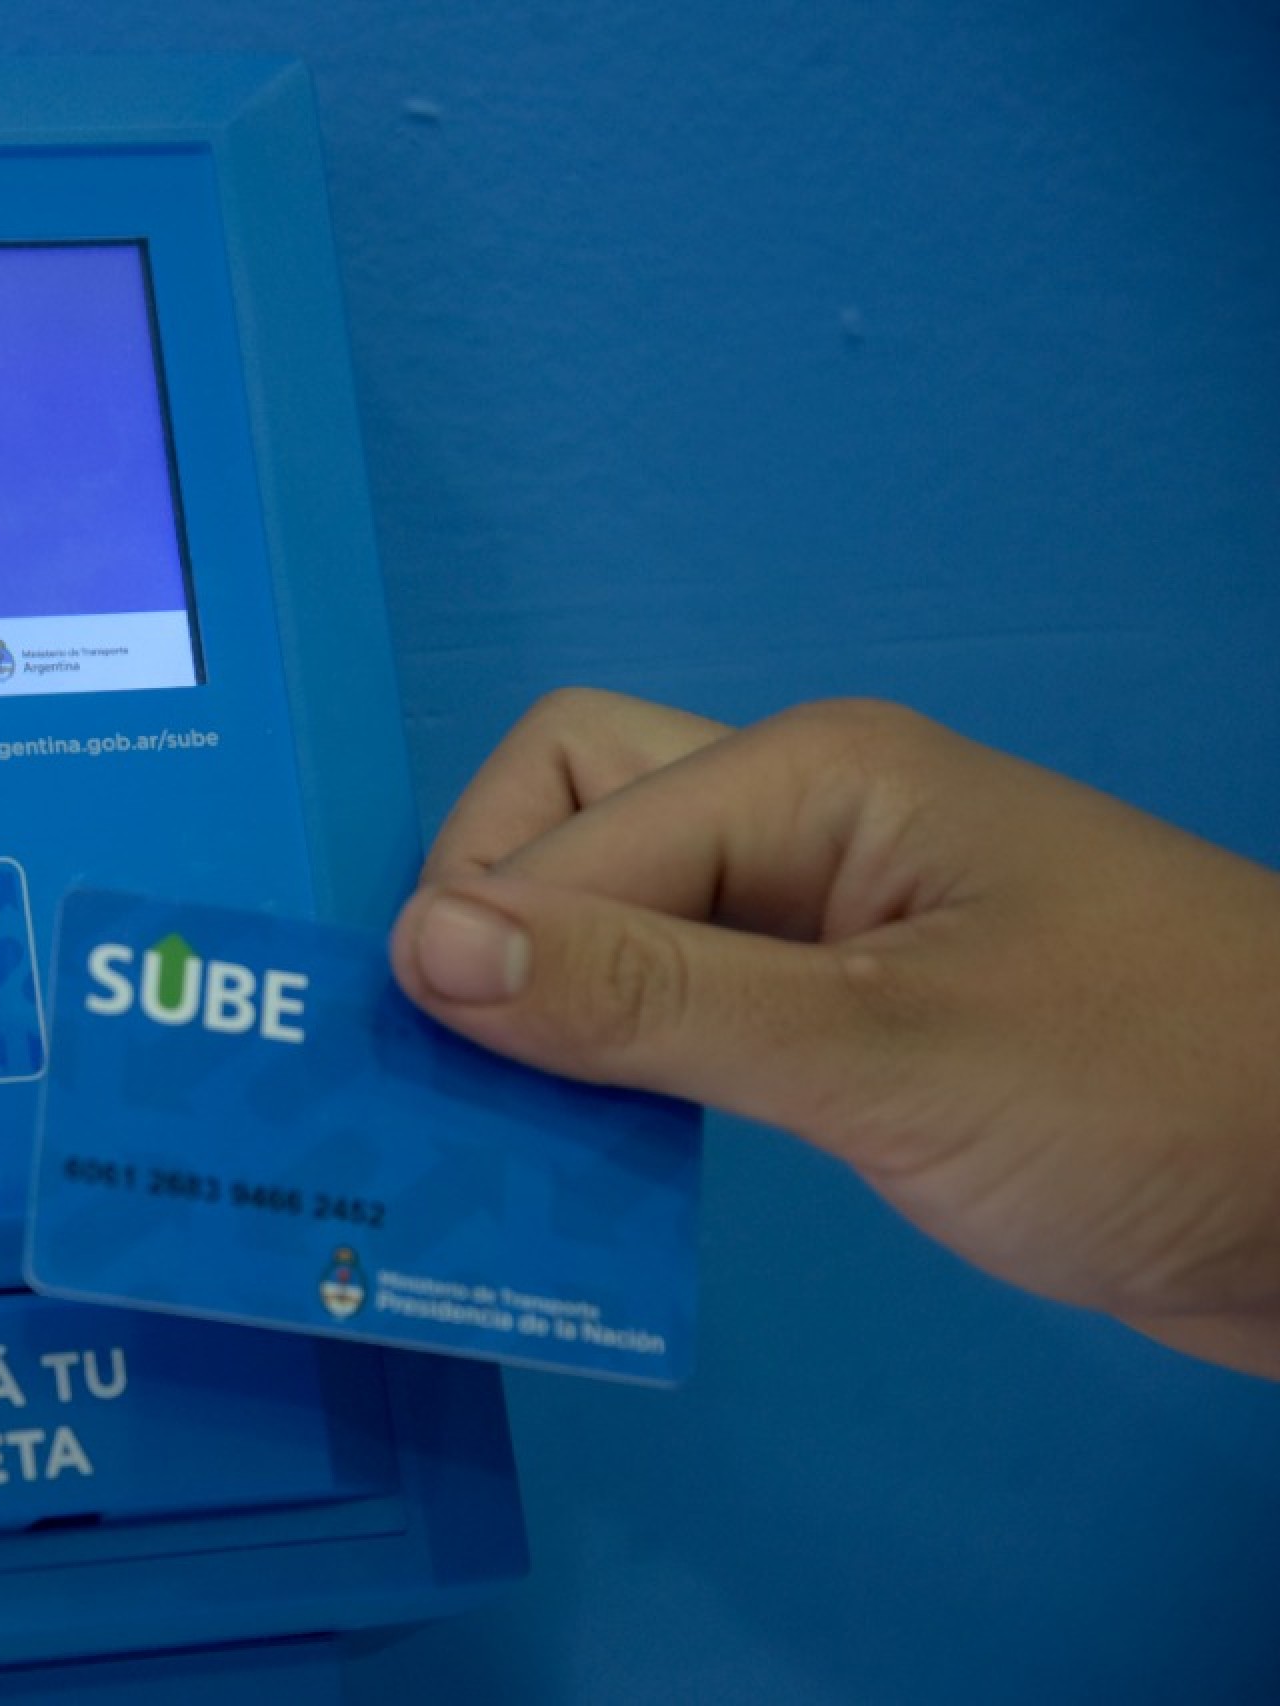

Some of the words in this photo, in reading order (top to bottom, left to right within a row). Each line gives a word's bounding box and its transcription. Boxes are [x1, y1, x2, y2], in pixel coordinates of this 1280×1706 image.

[23, 661, 81, 676] Argentina
[84, 936, 310, 1043] SUBE
[471, 1285, 497, 1304] de
[376, 1289, 513, 1332] Presidencia
[516, 1314, 549, 1337] de
[553, 1318, 577, 1341] la
[580, 1320, 666, 1355] Nación
[39, 1348, 127, 1402] TU
